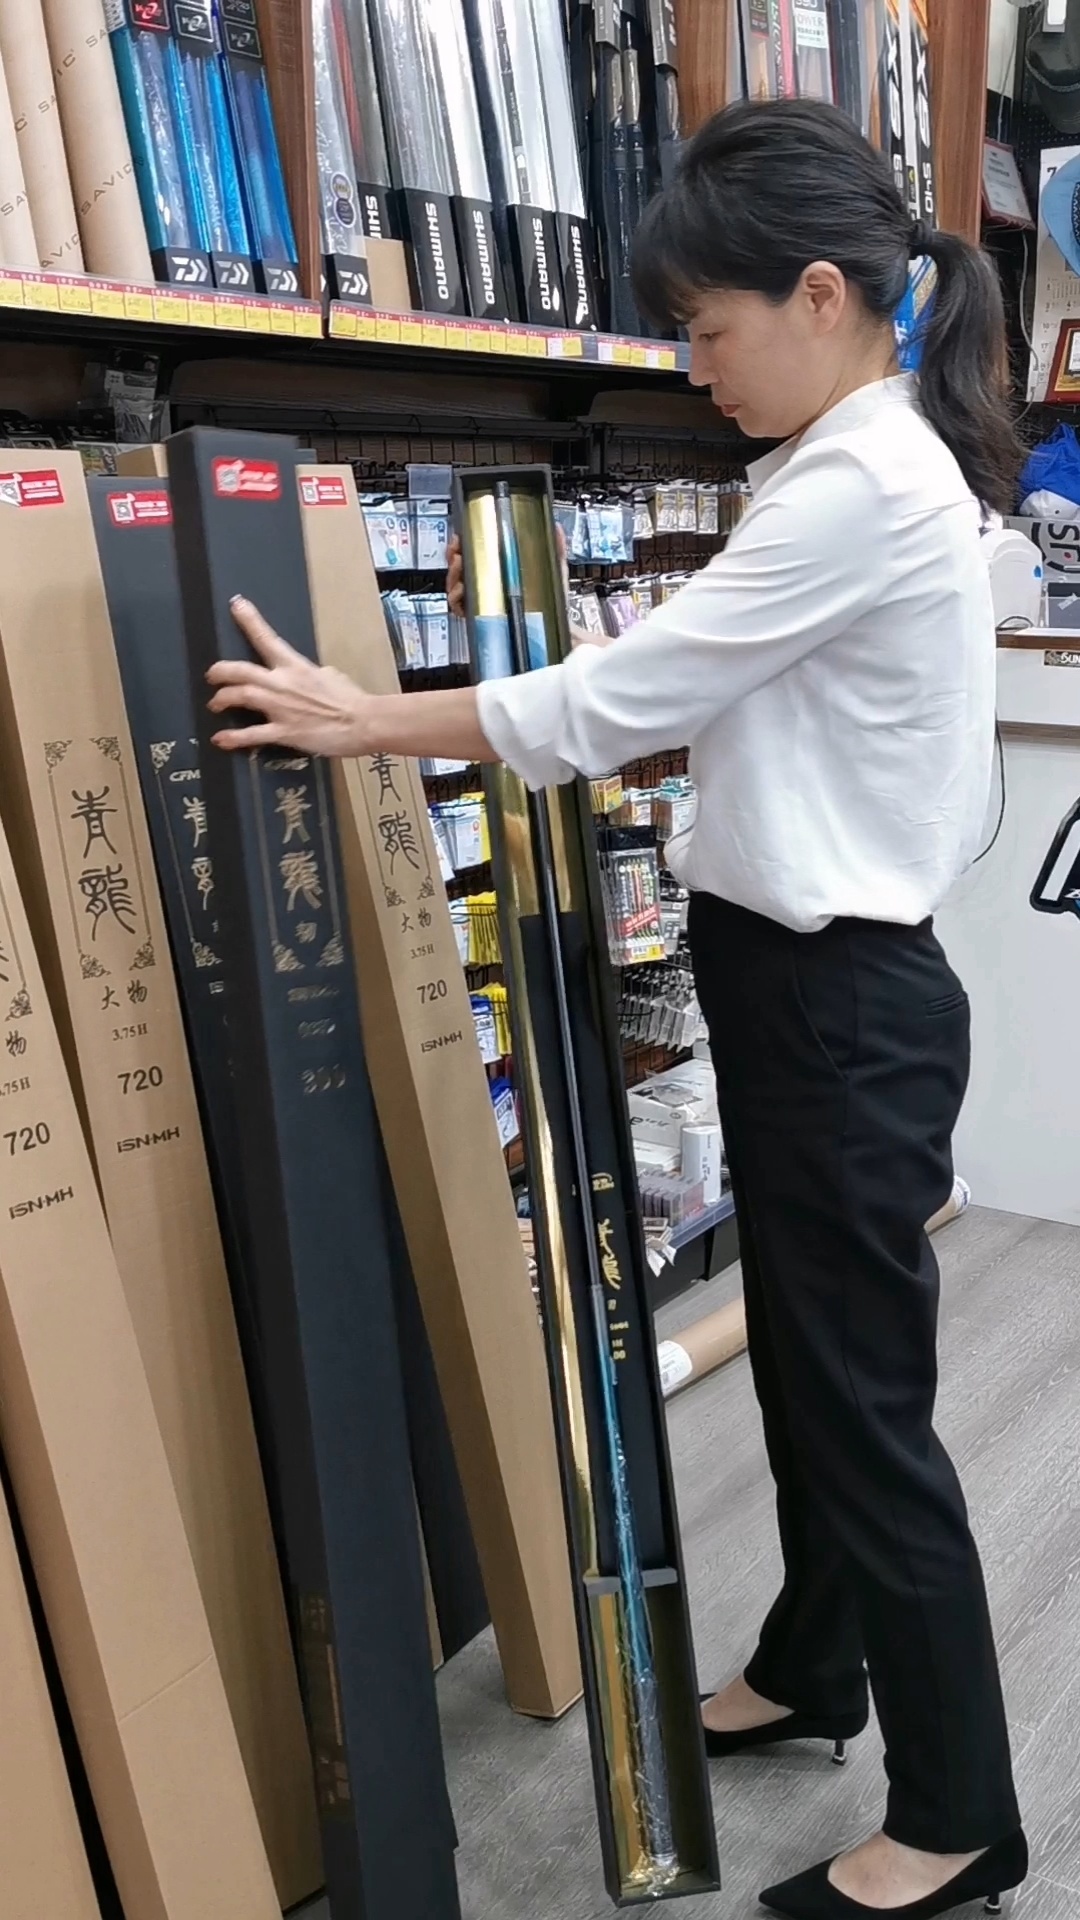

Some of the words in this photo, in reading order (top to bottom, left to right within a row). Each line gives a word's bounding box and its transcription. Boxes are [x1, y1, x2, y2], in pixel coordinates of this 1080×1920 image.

[425, 202, 449, 300] SHIMANO
[473, 210, 495, 305] SHIMANO
[532, 218, 551, 310] SHIMANO
[570, 226, 589, 316] SHIMANO
[417, 979, 447, 1004] 720
[117, 1065, 163, 1095] 720
[3, 1121, 51, 1156] 720
